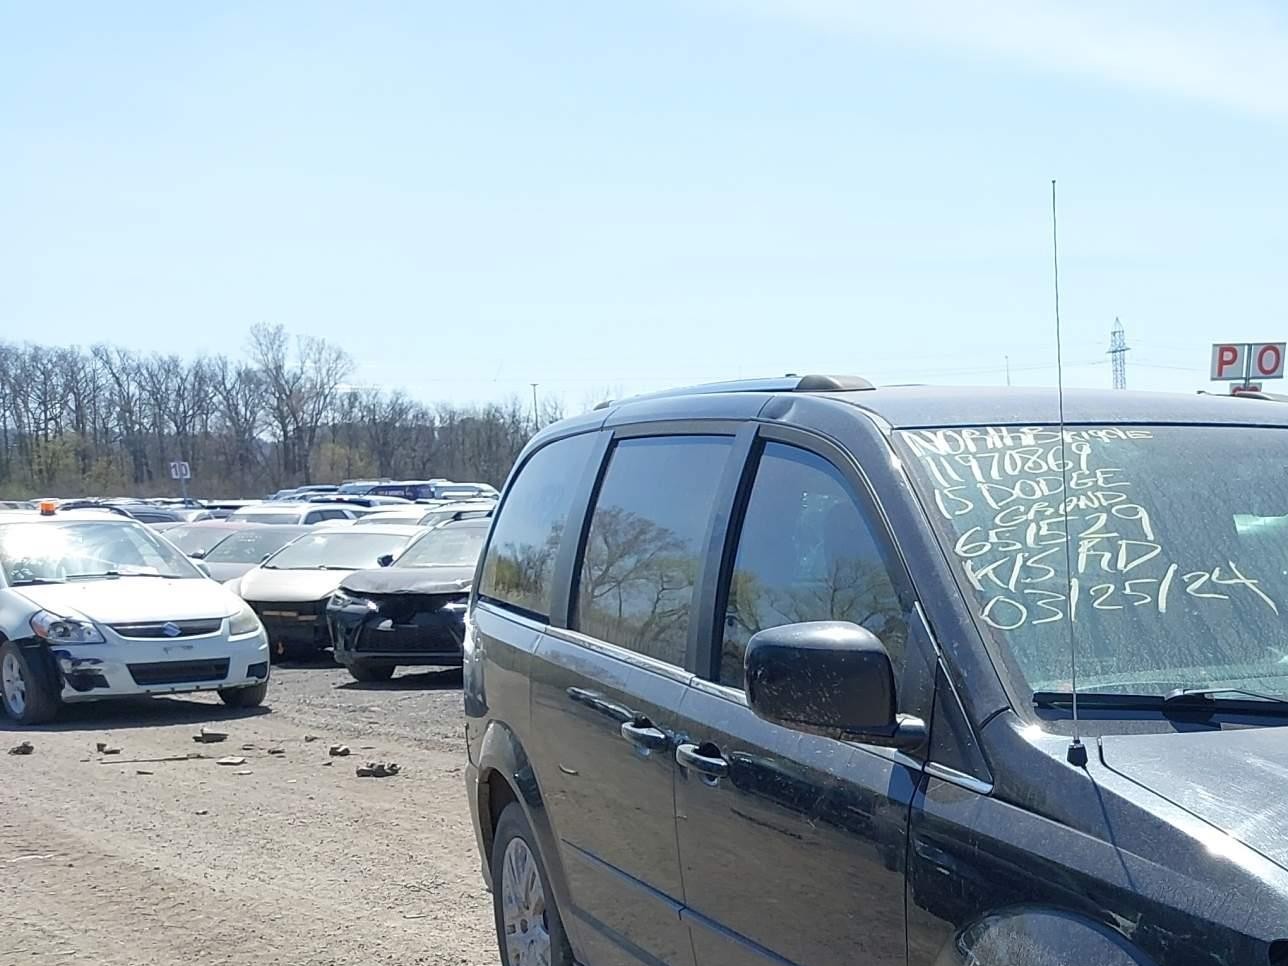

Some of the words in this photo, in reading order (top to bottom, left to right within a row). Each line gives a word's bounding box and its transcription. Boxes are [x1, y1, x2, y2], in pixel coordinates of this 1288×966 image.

[1216, 346, 1238, 378] P
[926, 441, 1092, 488] 11970869
[976, 468, 1131, 510] DODGE
[954, 504, 1154, 557] 651529
[980, 561, 1279, 630] 03/25/24
